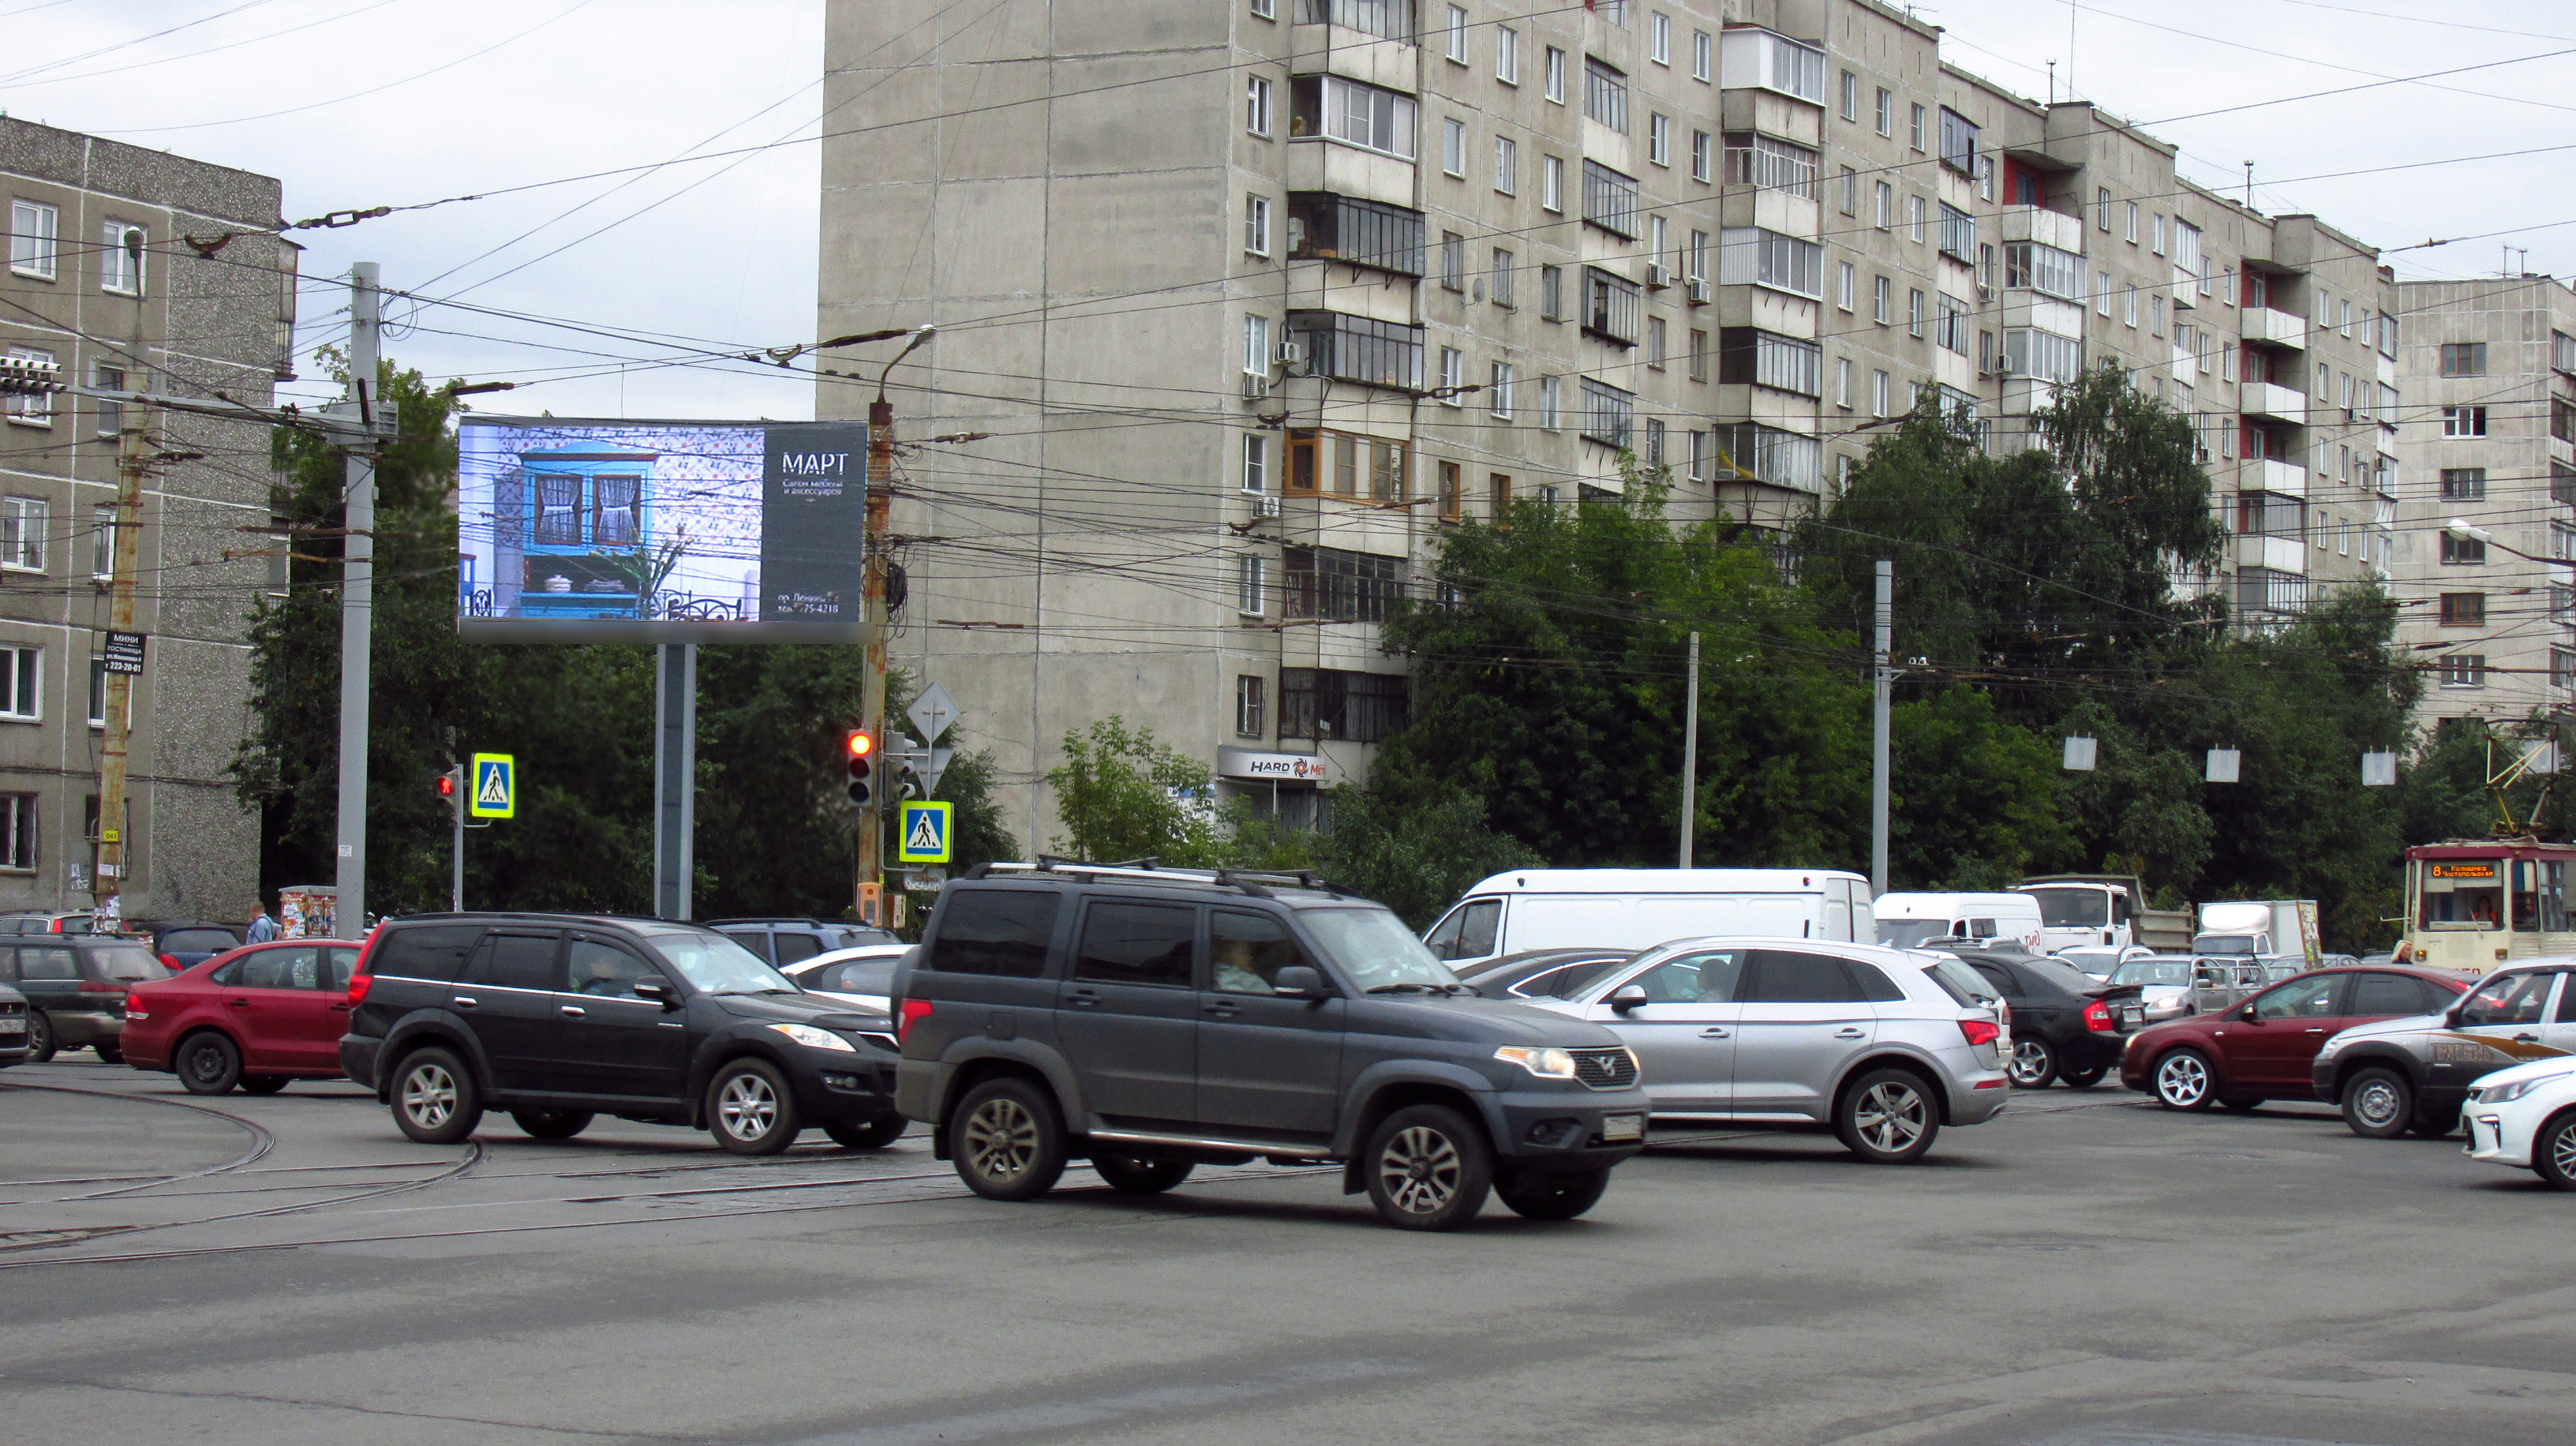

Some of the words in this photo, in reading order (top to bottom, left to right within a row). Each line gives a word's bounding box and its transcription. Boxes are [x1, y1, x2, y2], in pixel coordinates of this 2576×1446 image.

[782, 451, 849, 474] МАРТ
[113, 634, 139, 644] МИНИ
[107, 645, 142, 654] ГОСТИНИЦА
[110, 661, 141, 672] 223-20-01
[1250, 762, 1290, 773] HARD
[2432, 866, 2441, 876] 8
